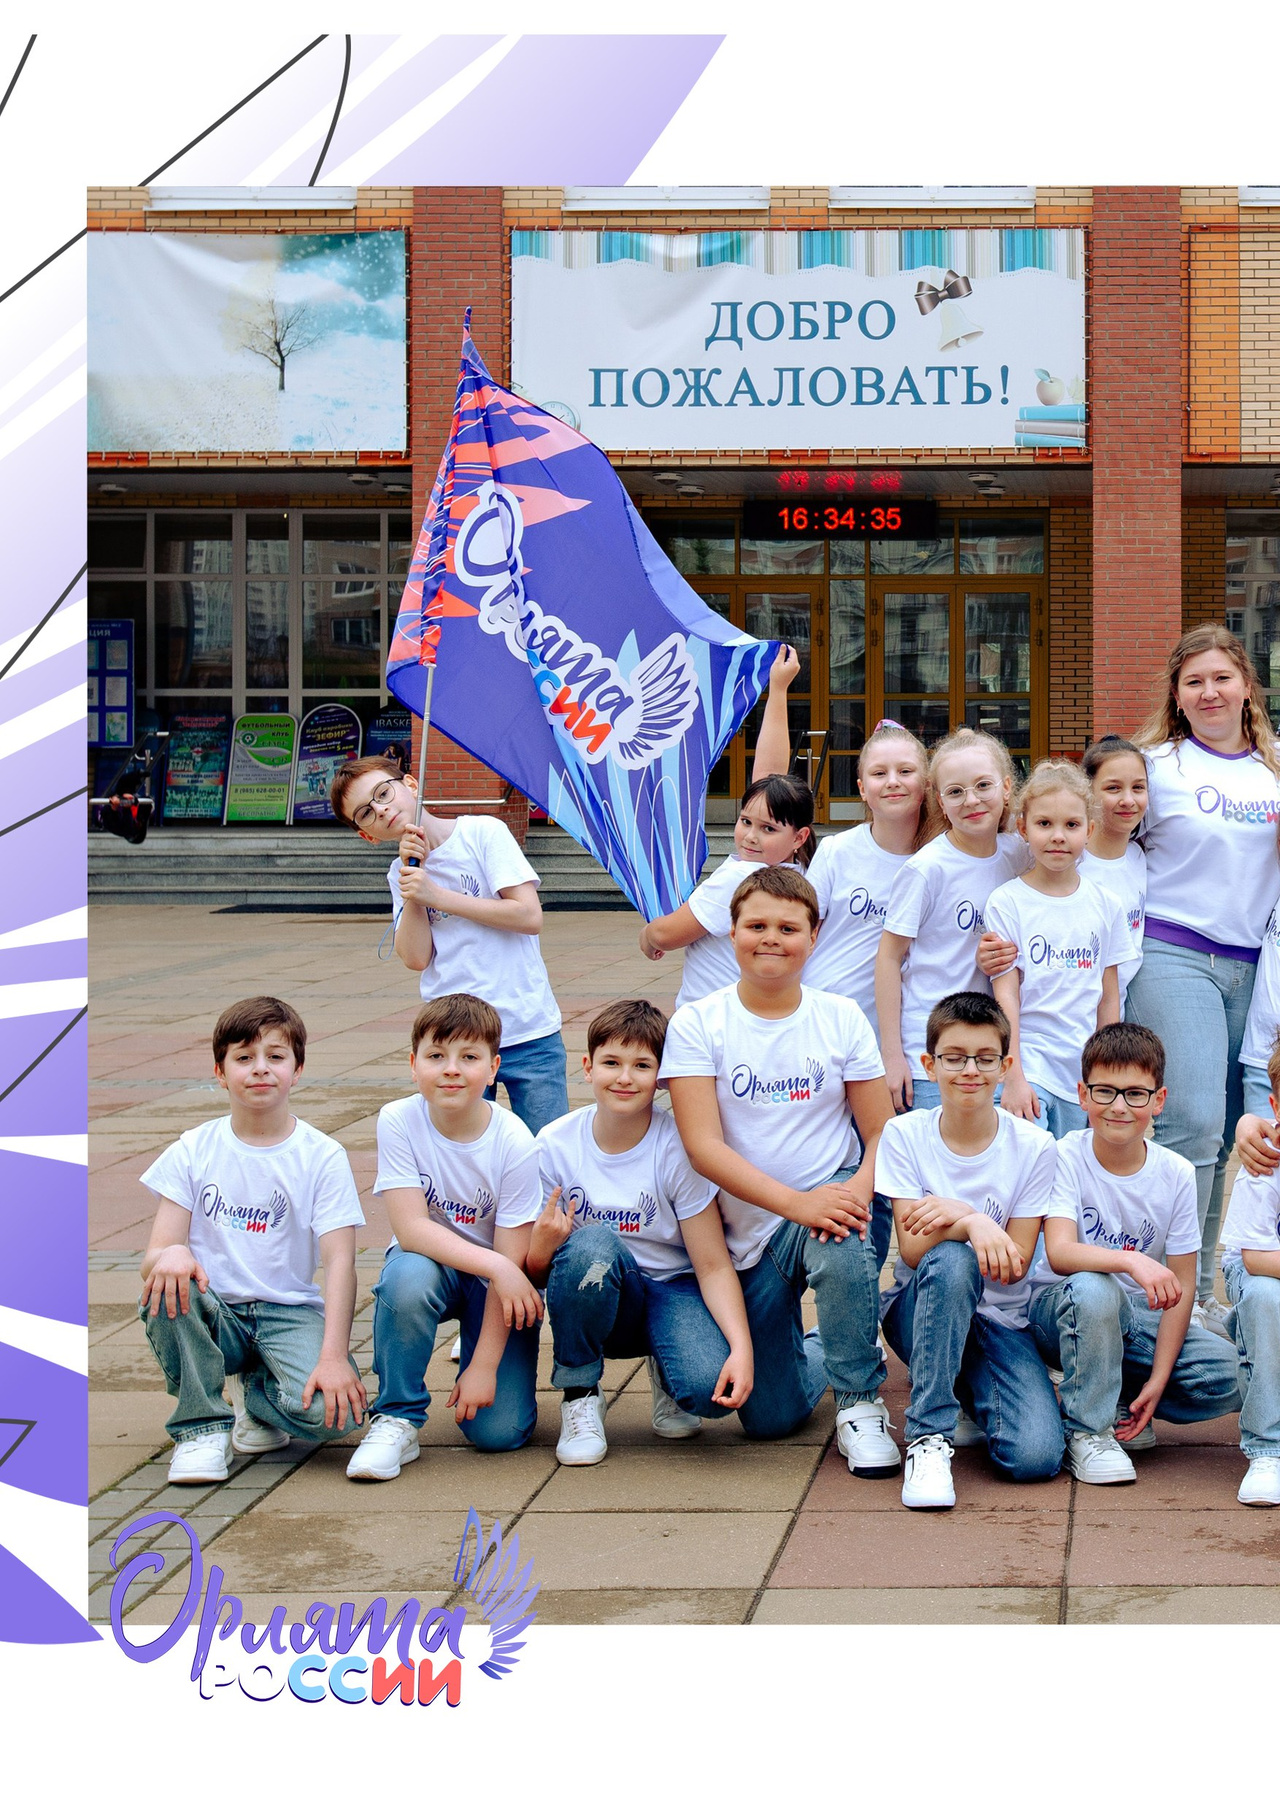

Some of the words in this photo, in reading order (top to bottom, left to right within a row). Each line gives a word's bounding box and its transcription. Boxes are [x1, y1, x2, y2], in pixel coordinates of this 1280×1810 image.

[704, 299, 896, 351] ДОБРО
[588, 364, 1010, 408] ПОЖАЛОВАТЬ!
[777, 506, 902, 531] 16:34:35
[1223, 810, 1280, 824] РОССИ
[1028, 934, 1092, 967] Орлята
[731, 1063, 810, 1101] Орлята
[200, 1183, 271, 1223] Орлята
[568, 1186, 641, 1224] Орлята
